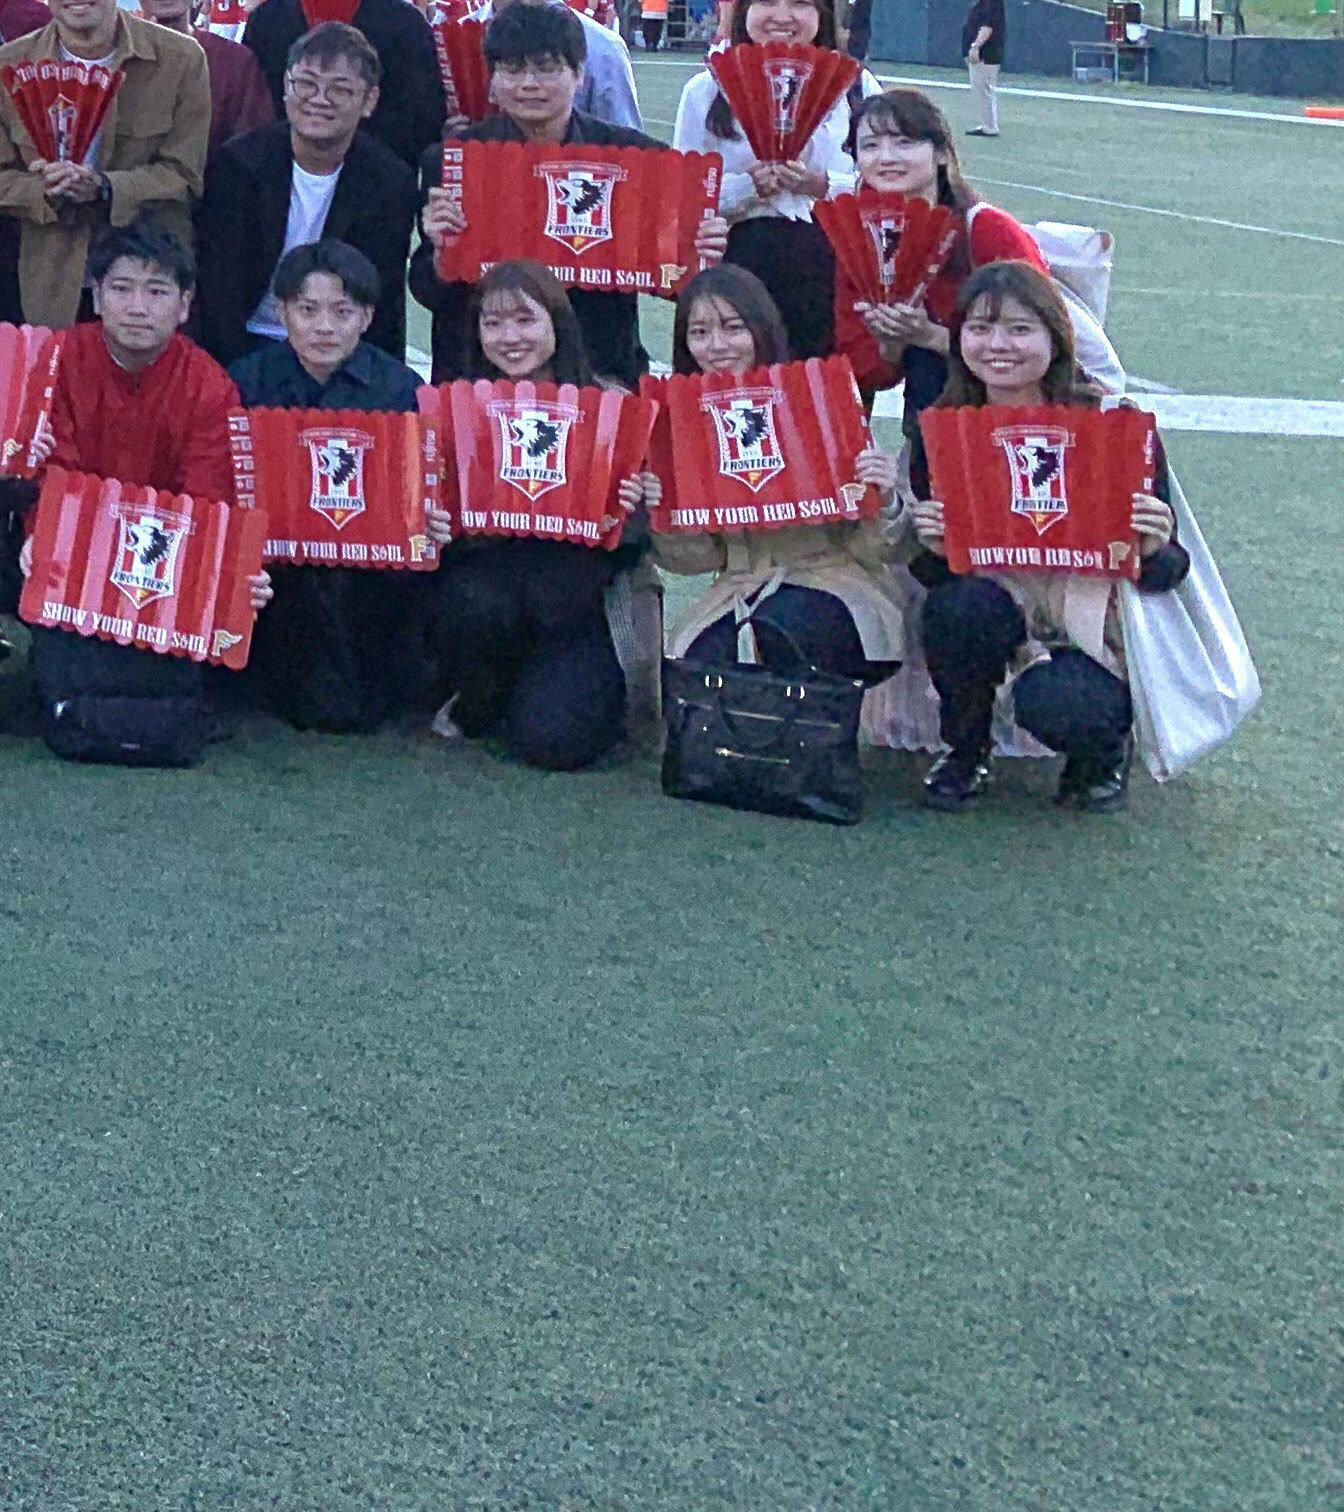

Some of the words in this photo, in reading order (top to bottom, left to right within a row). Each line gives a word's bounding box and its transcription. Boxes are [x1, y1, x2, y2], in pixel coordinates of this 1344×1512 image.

[580, 268, 611, 285] RED
[722, 456, 782, 471] FRONTIERS
[503, 467, 564, 481] FRONTIERS
[313, 497, 363, 509] FRONTIERS
[491, 511, 531, 530] YOUR
[535, 514, 564, 533] RED
[714, 506, 759, 525] YOUR
[763, 502, 796, 521] RED
[302, 541, 338, 558] YOUR
[342, 543, 368, 560] RED
[42, 601, 87, 626] SHOW
[91, 611, 133, 638] YOUR
[136, 623, 167, 645] RED
